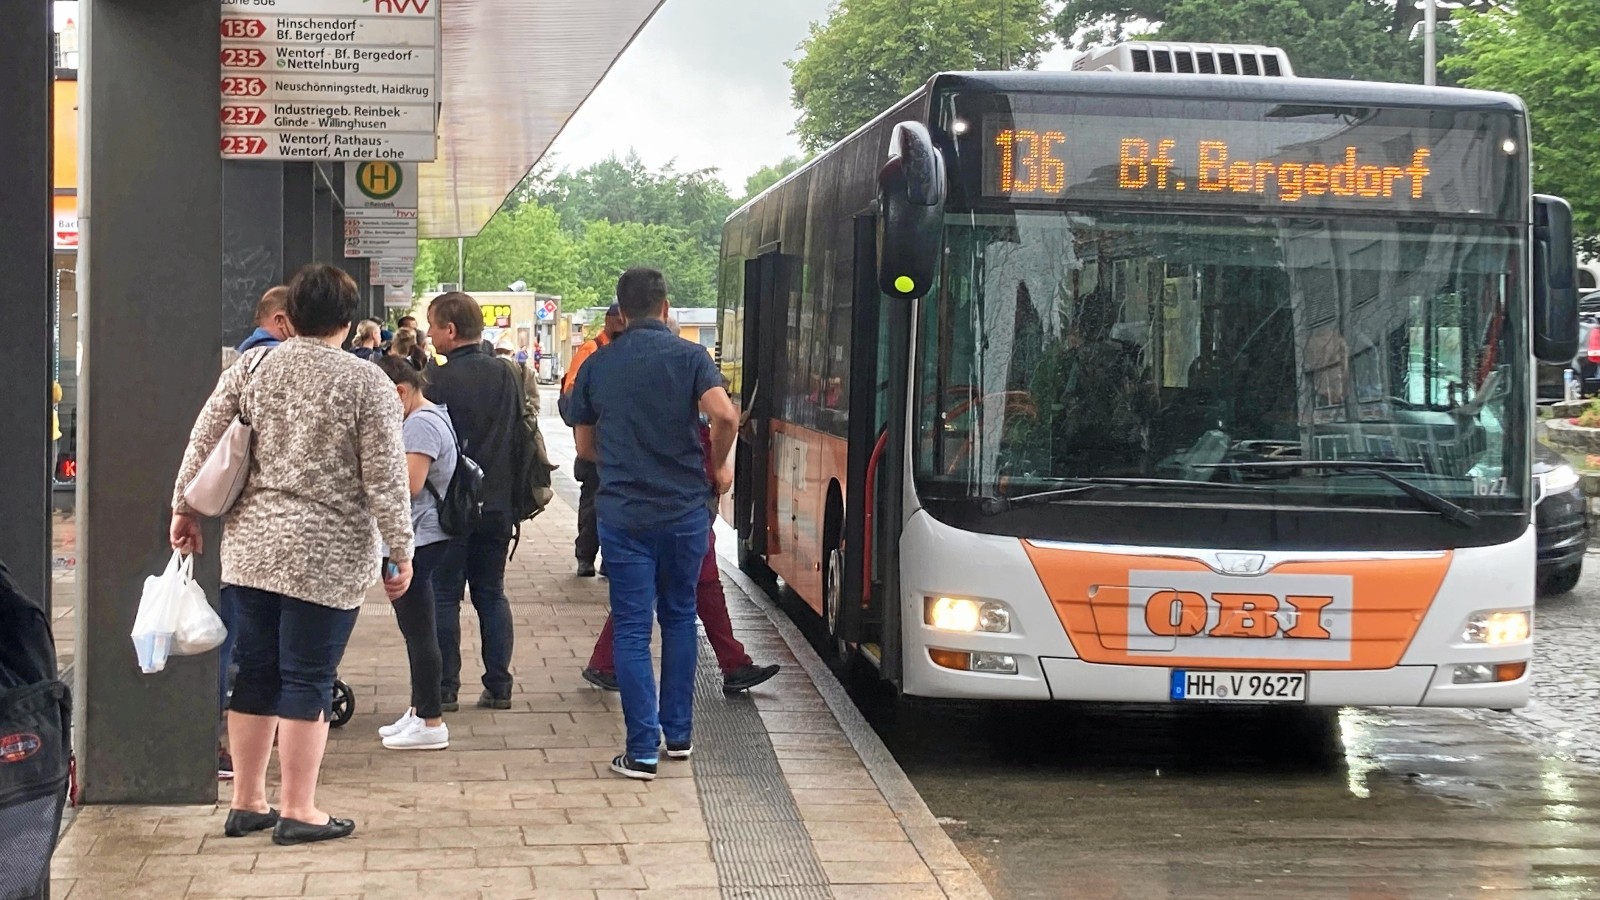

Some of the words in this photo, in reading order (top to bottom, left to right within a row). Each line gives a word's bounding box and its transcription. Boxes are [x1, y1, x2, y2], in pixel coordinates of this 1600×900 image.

[224, 20, 259, 37] 136
[277, 18, 357, 30] Hinschendorf
[277, 30, 293, 40] Bf.
[295, 30, 356, 43] Bergedorf
[224, 49, 260, 66] 235
[276, 47, 326, 58] Wentorf
[335, 48, 351, 59] Bf.
[353, 49, 413, 63] Bergedorf
[287, 58, 360, 73] Nettelnburg
[223, 78, 261, 96] 236
[275, 81, 380, 96] Neuschönningstedt,
[381, 84, 430, 98] Haidkrug
[223, 107, 260, 124] 237
[274, 104, 351, 118] Industriegeb.
[354, 106, 401, 118] Reinbek
[274, 116, 309, 128] Glinde
[318, 117, 387, 131] Willinghusen
[223, 137, 262, 154] 237
[279, 133, 331, 146] Wentorf,
[334, 134, 382, 146] Rathaus
[279, 145, 331, 158] Wentorf,
[333, 147, 350, 158] An
[353, 147, 373, 158] der
[375, 148, 405, 159] Lohe
[996, 128, 1065, 193] 136
[1119, 137, 1186, 191] Bf.
[1198, 140, 1430, 202] Bergedorf
[1472, 476, 1508, 496] 1627
[1145, 590, 1334, 640] OBI
[1186, 674, 1215, 696] HH
[1230, 676, 1244, 696] V
[1249, 676, 1303, 697] 9627
